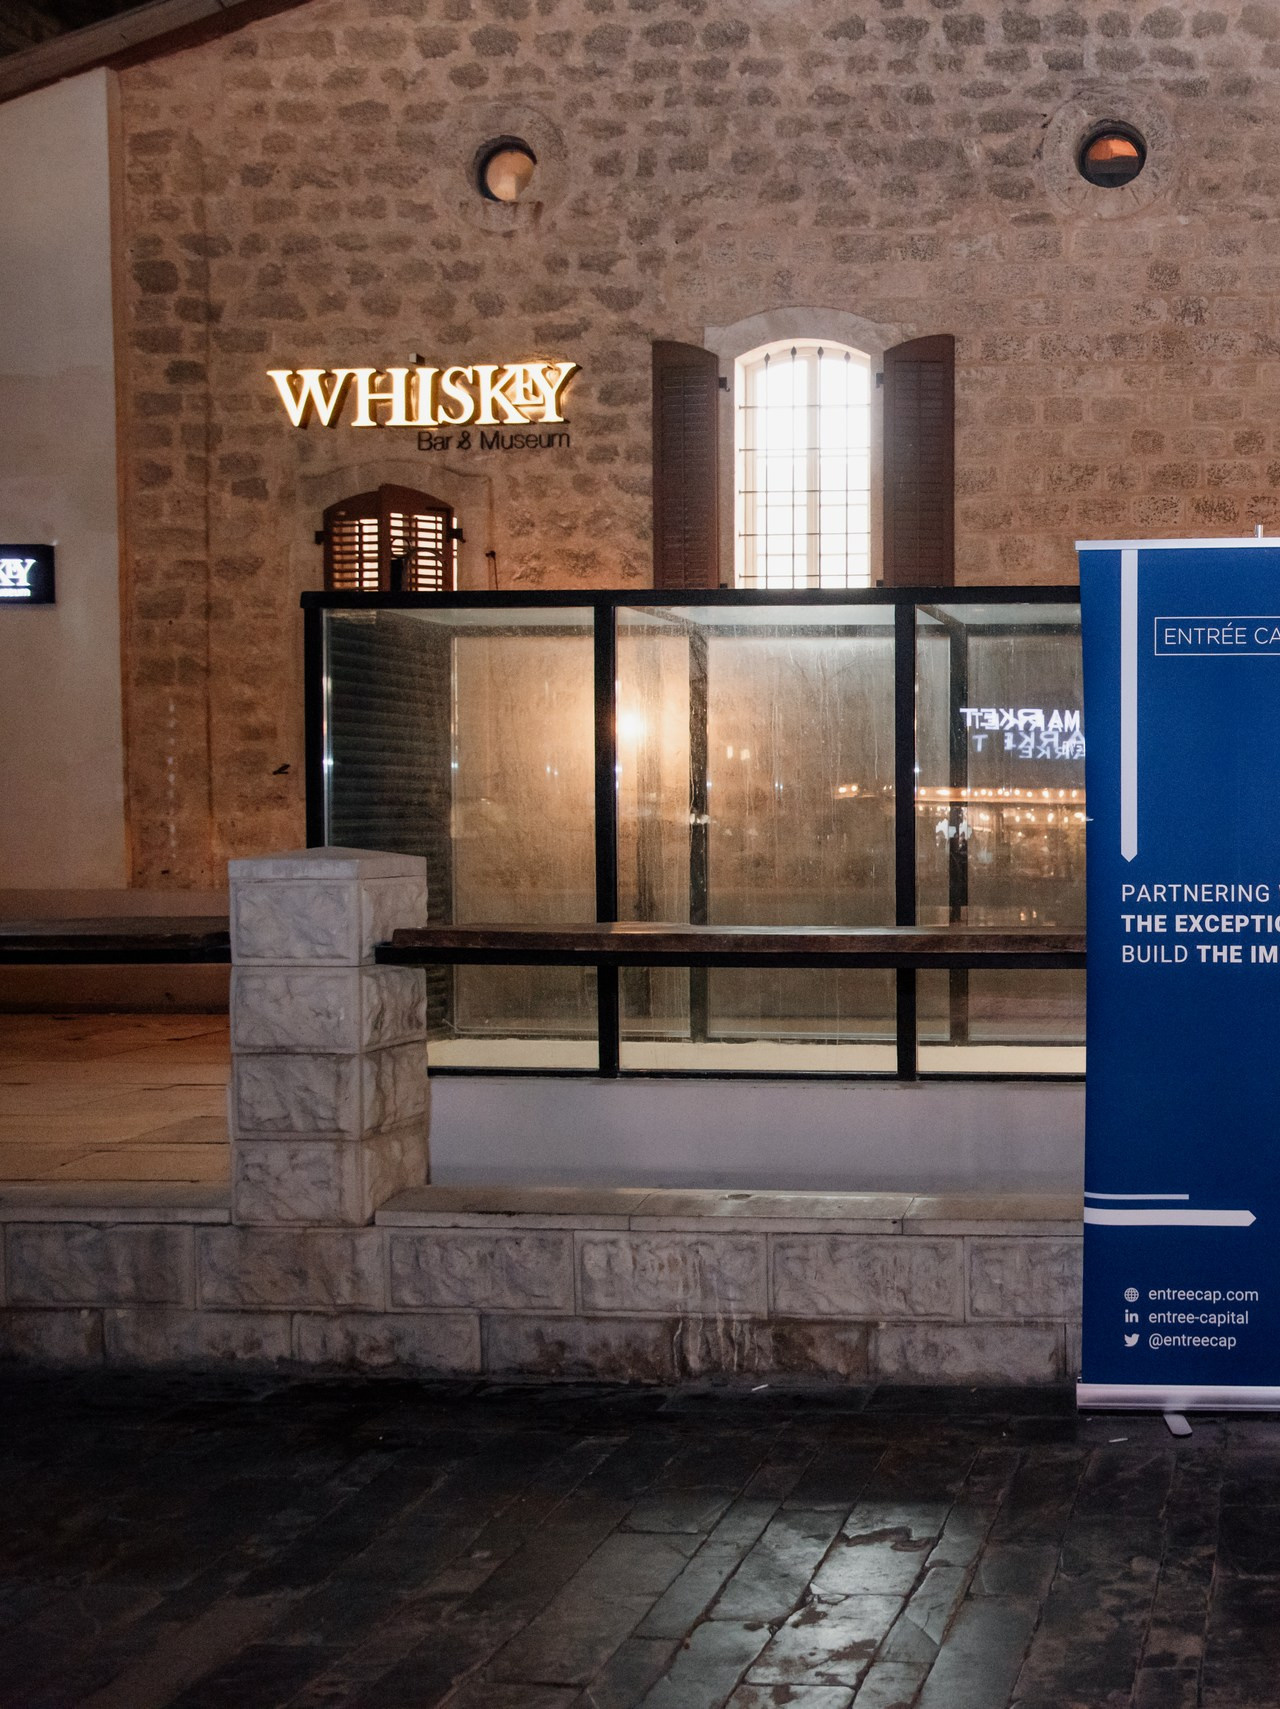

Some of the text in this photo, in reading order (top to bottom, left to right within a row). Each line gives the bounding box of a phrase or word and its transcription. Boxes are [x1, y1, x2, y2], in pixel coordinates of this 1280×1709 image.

[266, 356, 577, 428] WHISKEY
[416, 429, 571, 451] Bar & Museum
[1163, 621, 1248, 646] ENTRÉE
[1121, 884, 1270, 902] PARTNERING
[1121, 914, 1168, 933] THE
[1121, 945, 1189, 963] BUILD
[1196, 945, 1243, 964] THE
[1148, 1287, 1260, 1304] entreecap.com
[1148, 1309, 1250, 1327] entree-capital
[1148, 1332, 1238, 1350] @entreecap
